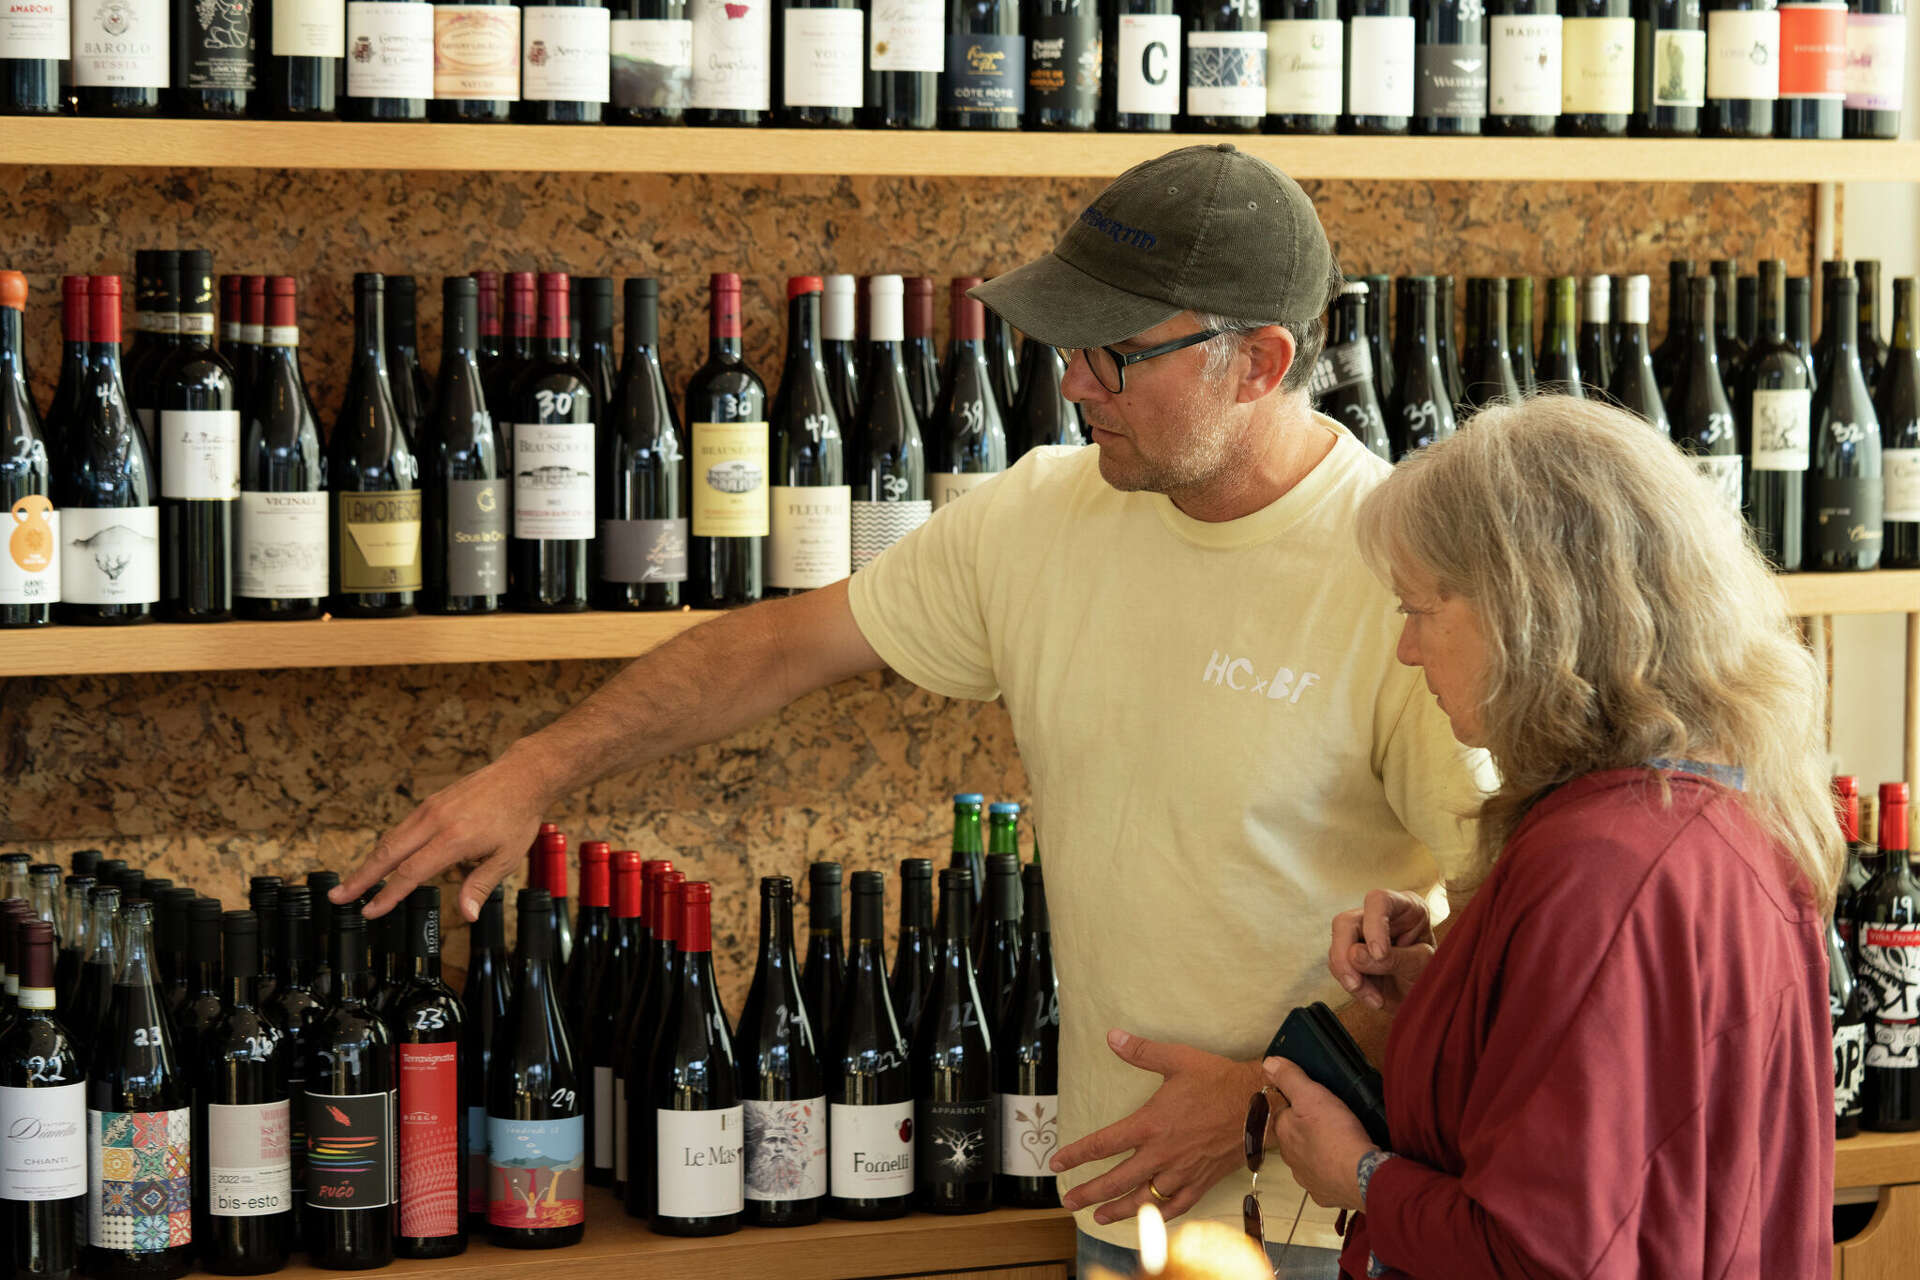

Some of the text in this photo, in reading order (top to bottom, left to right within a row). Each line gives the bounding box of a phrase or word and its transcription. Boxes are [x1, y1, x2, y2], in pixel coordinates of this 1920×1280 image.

[10, 5, 53, 14] AMARONE
[83, 41, 152, 54] BAROLO
[1141, 41, 1168, 86] C
[535, 390, 573, 418] 30
[805, 413, 838, 443] 42
[1403, 400, 1439, 436] 39
[416, 1008, 446, 1029] 23
[29, 1055, 68, 1082] 22
[550, 1087, 576, 1111] 29
[931, 1106, 986, 1115] APPARENTE
[24, 1156, 69, 1166] CHIANTI
[683, 1145, 736, 1167] Le Mas
[853, 1152, 909, 1173] Fornelli
[218, 1175, 241, 1185] 2022
[218, 1194, 280, 1210] bis-esto
